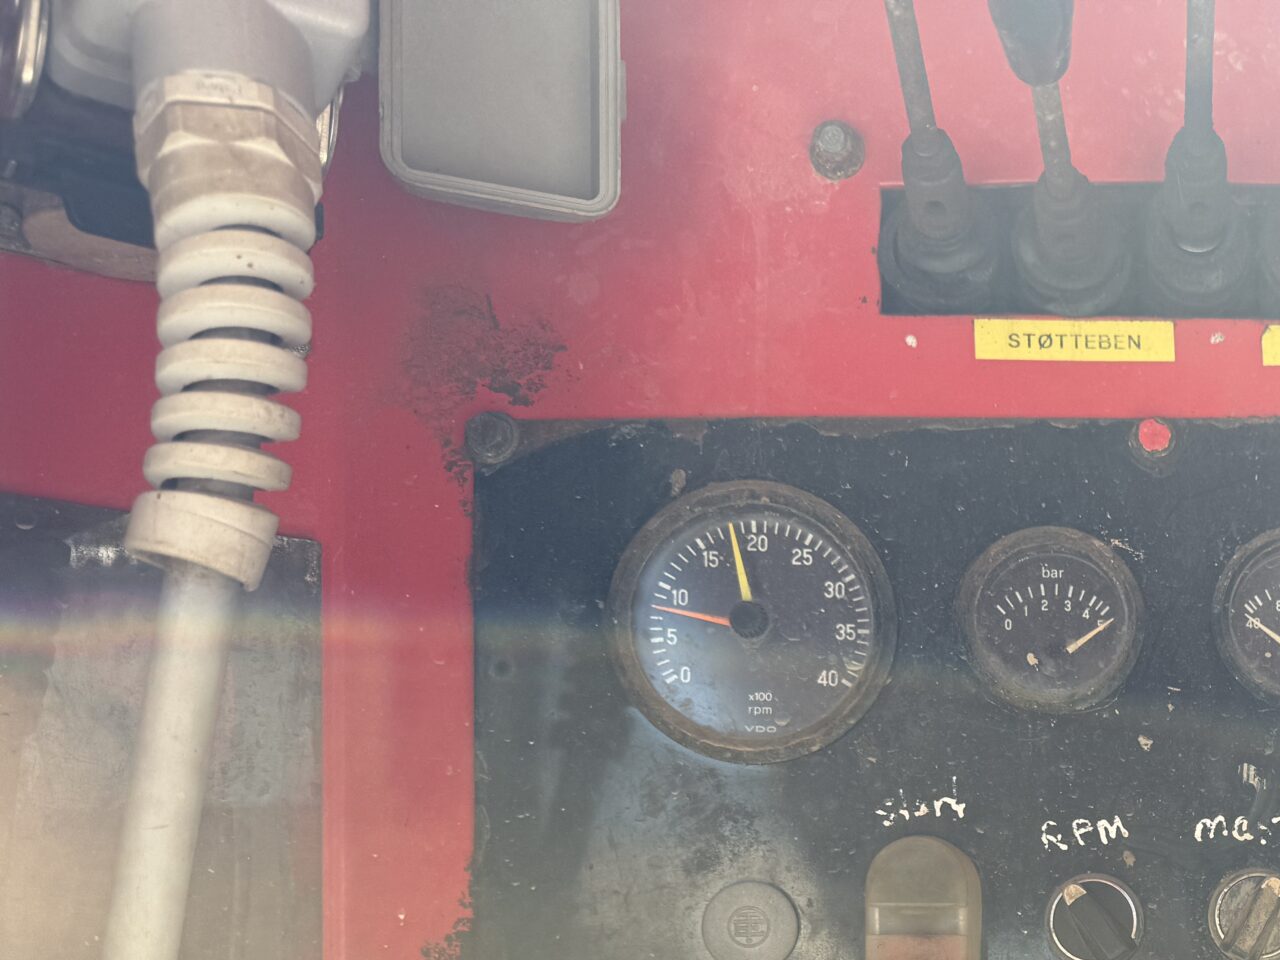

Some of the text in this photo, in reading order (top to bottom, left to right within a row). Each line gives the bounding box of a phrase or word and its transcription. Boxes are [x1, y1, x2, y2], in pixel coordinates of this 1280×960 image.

[1008, 333, 1142, 351] STØTTEBEN
[747, 535, 768, 552] 20
[703, 551, 718, 567] 15
[792, 549, 813, 565] 25
[1042, 567, 1064, 578] bar
[672, 589, 688, 606] 10
[824, 582, 845, 598] 30
[1024, 606, 1028, 616] 1
[1041, 600, 1048, 611] 2
[1064, 601, 1072, 611] 3
[1082, 609, 1090, 620] 4
[836, 624, 856, 640] 35
[1005, 619, 1012, 630] 0
[667, 629, 677, 645] 5
[680, 667, 691, 683] 0
[817, 670, 838, 686] 40
[748, 692, 772, 701] x100
[748, 705, 772, 715] rpm
[744, 725, 777, 733] VDO
